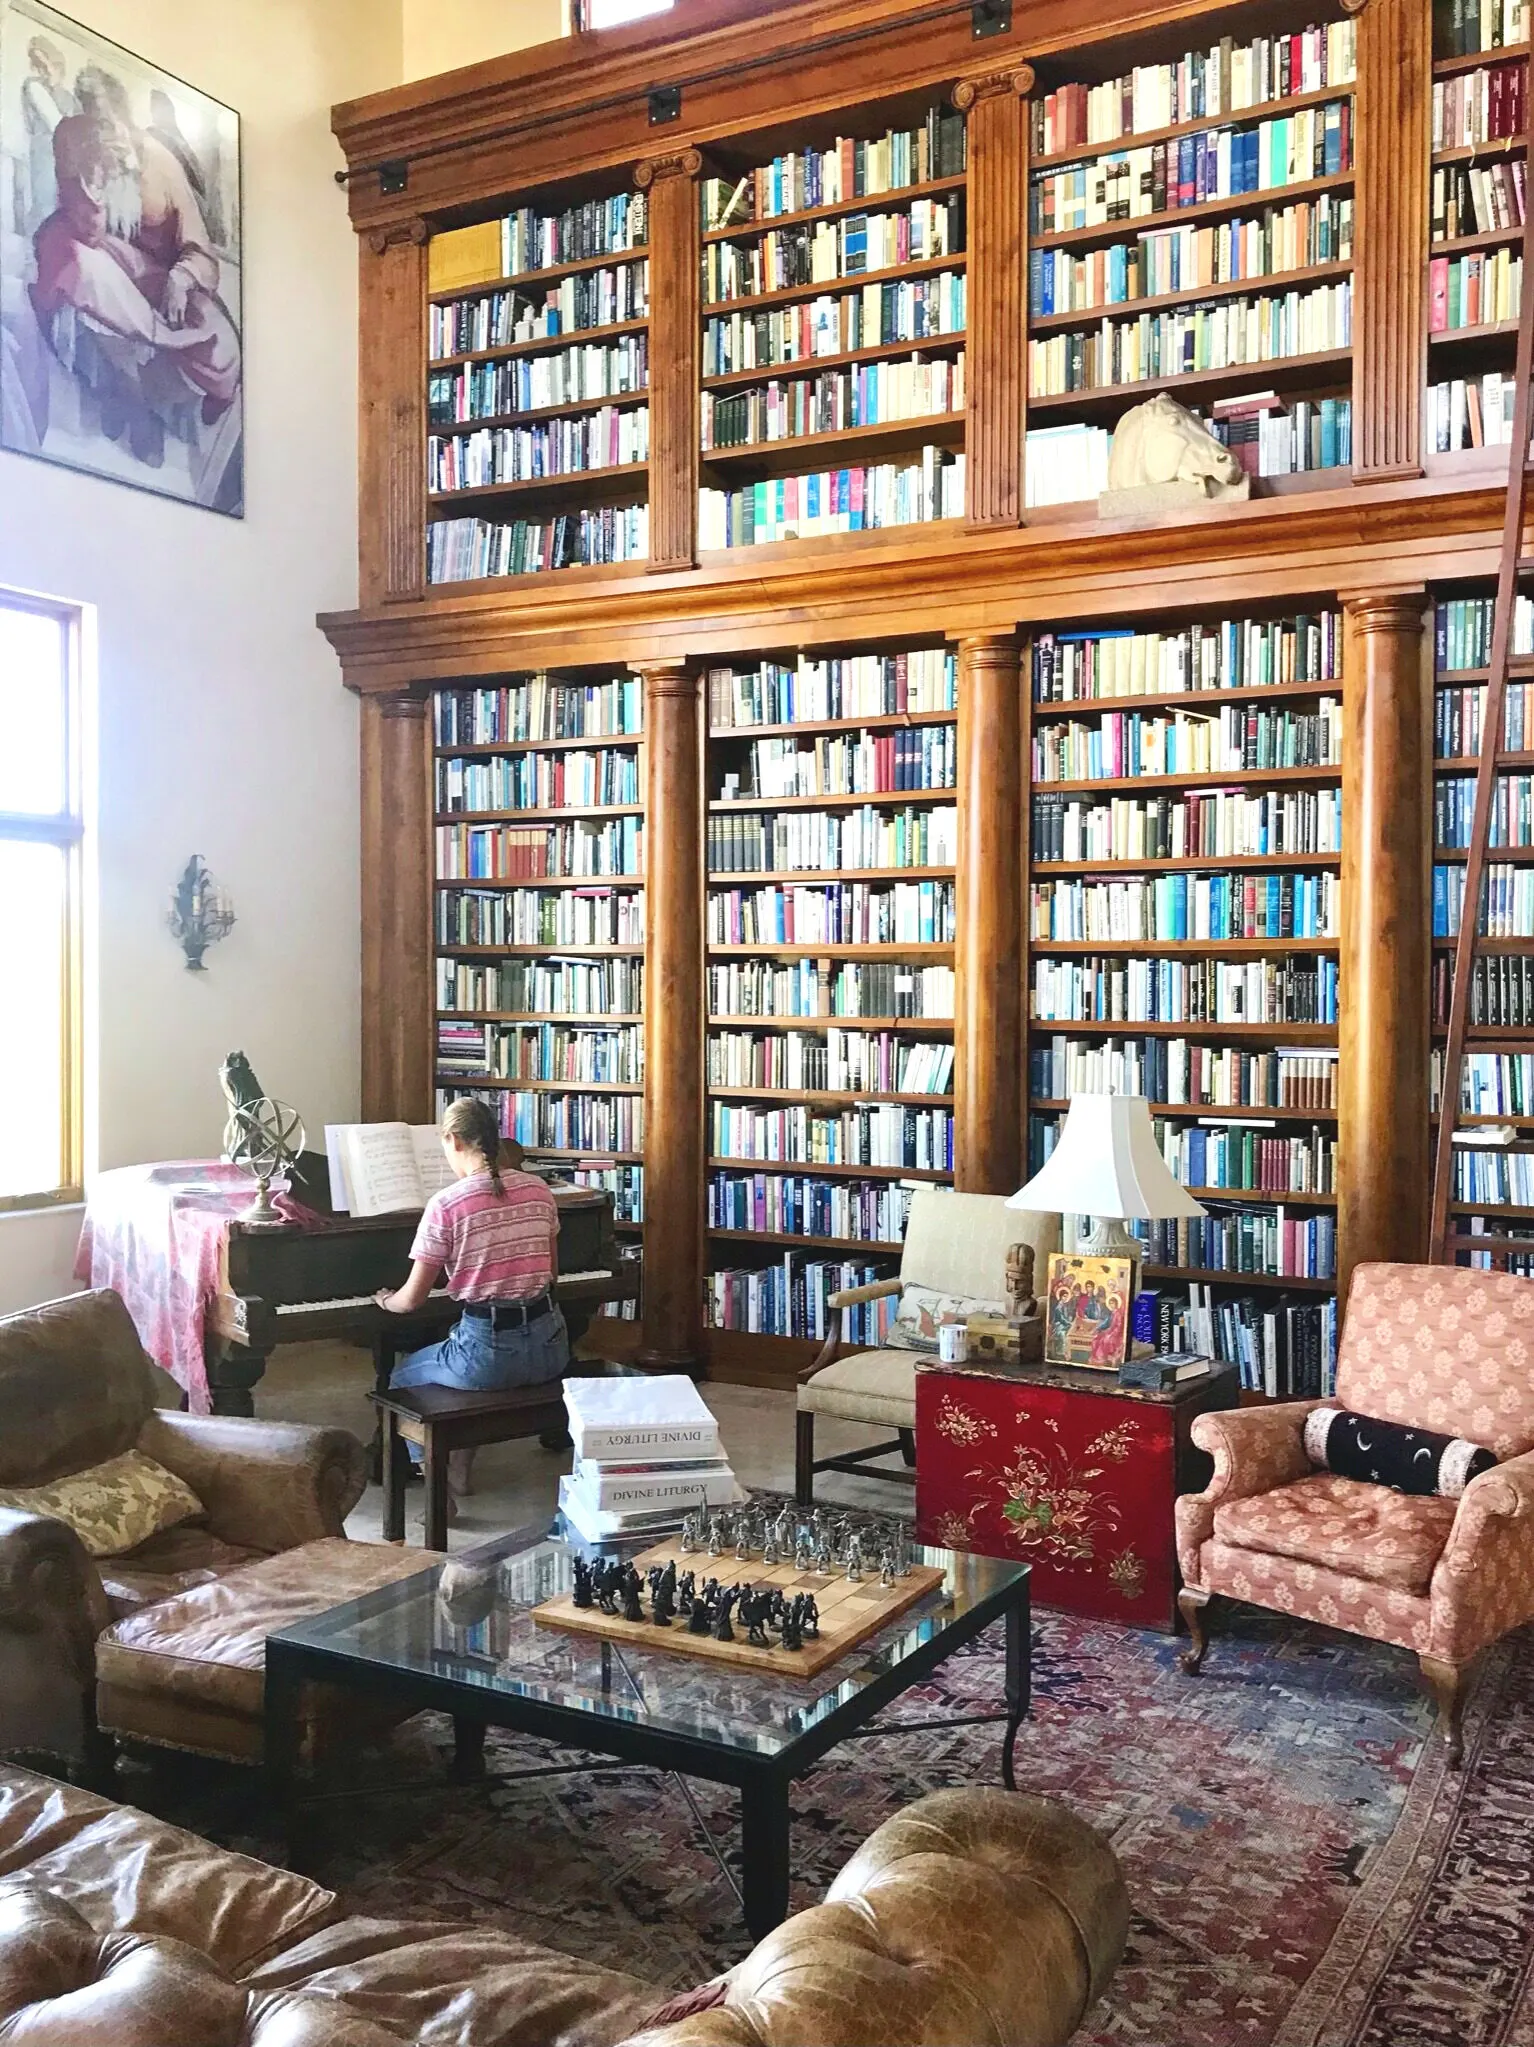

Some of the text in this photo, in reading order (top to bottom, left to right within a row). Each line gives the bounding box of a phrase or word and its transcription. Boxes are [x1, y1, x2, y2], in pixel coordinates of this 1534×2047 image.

[1160, 1303, 1170, 1323] NEW
[1160, 1323, 1170, 1344] YORK
[606, 1433, 658, 1446] LITURGY
[662, 1431, 701, 1442] DIVINE
[613, 1484, 706, 1501] DIVINE LITURGY
